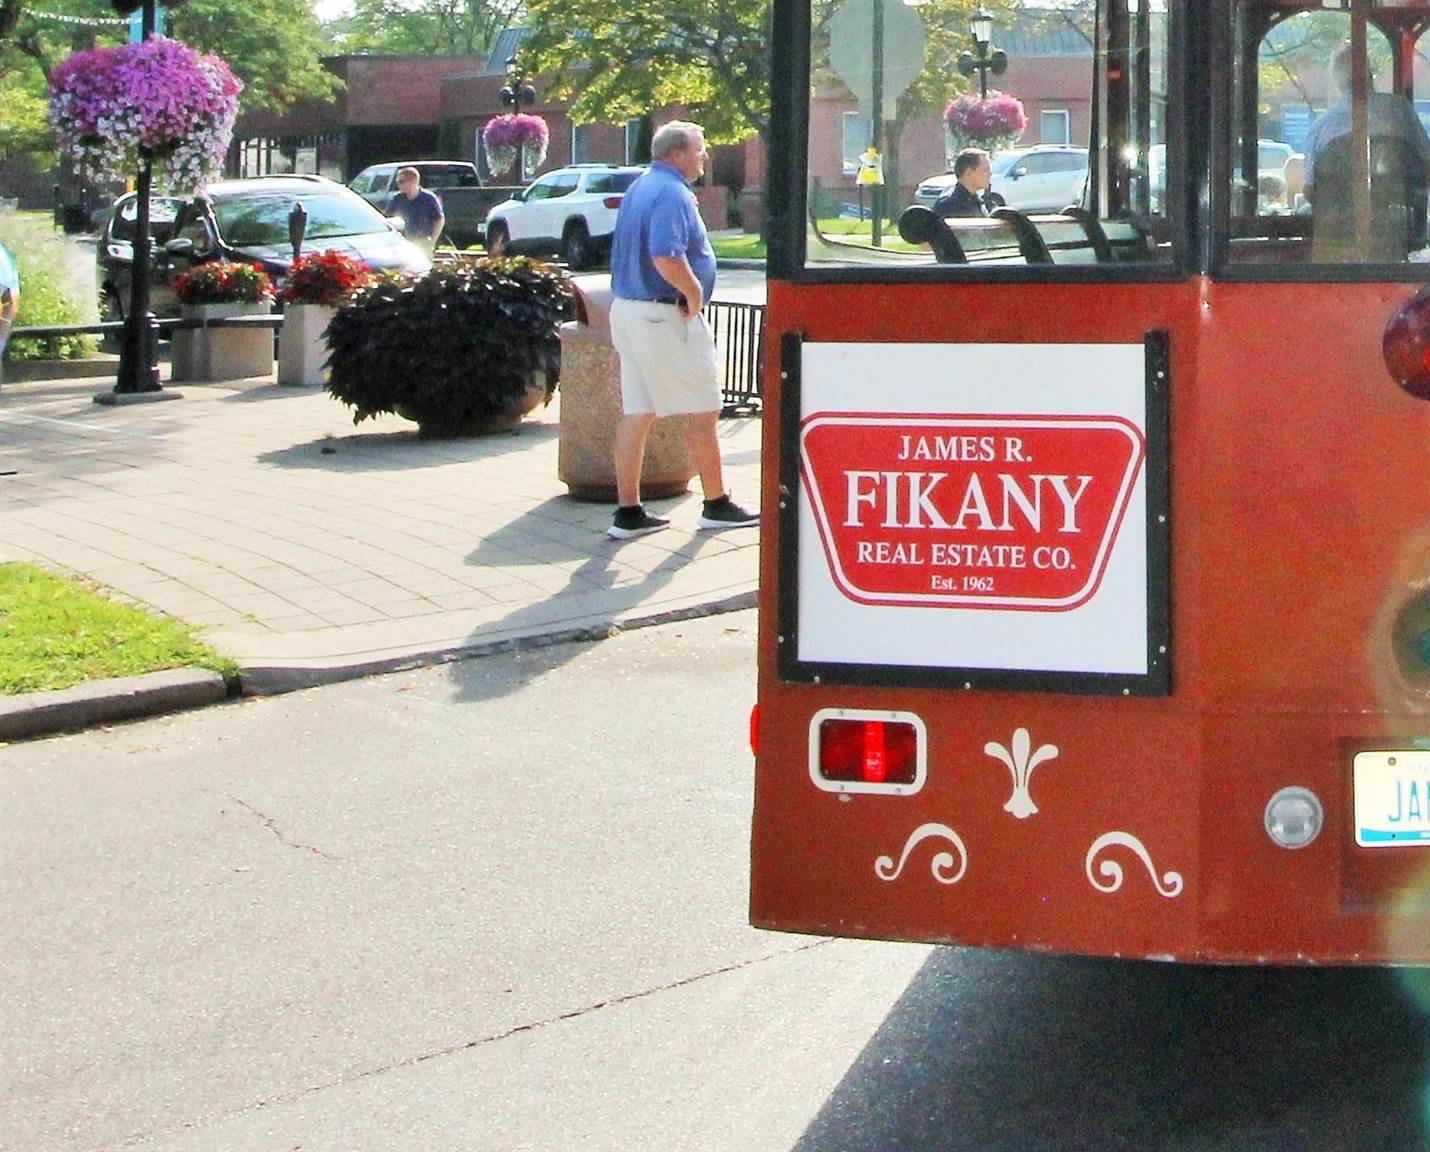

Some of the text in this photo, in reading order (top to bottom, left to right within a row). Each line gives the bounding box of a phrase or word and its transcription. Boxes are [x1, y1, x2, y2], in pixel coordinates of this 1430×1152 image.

[897, 435, 1033, 462] JAMES R.
[842, 470, 1093, 533] FIKANY
[857, 541, 1077, 570] REAL ESTATE CO.
[931, 575, 995, 592] Est. 1962
